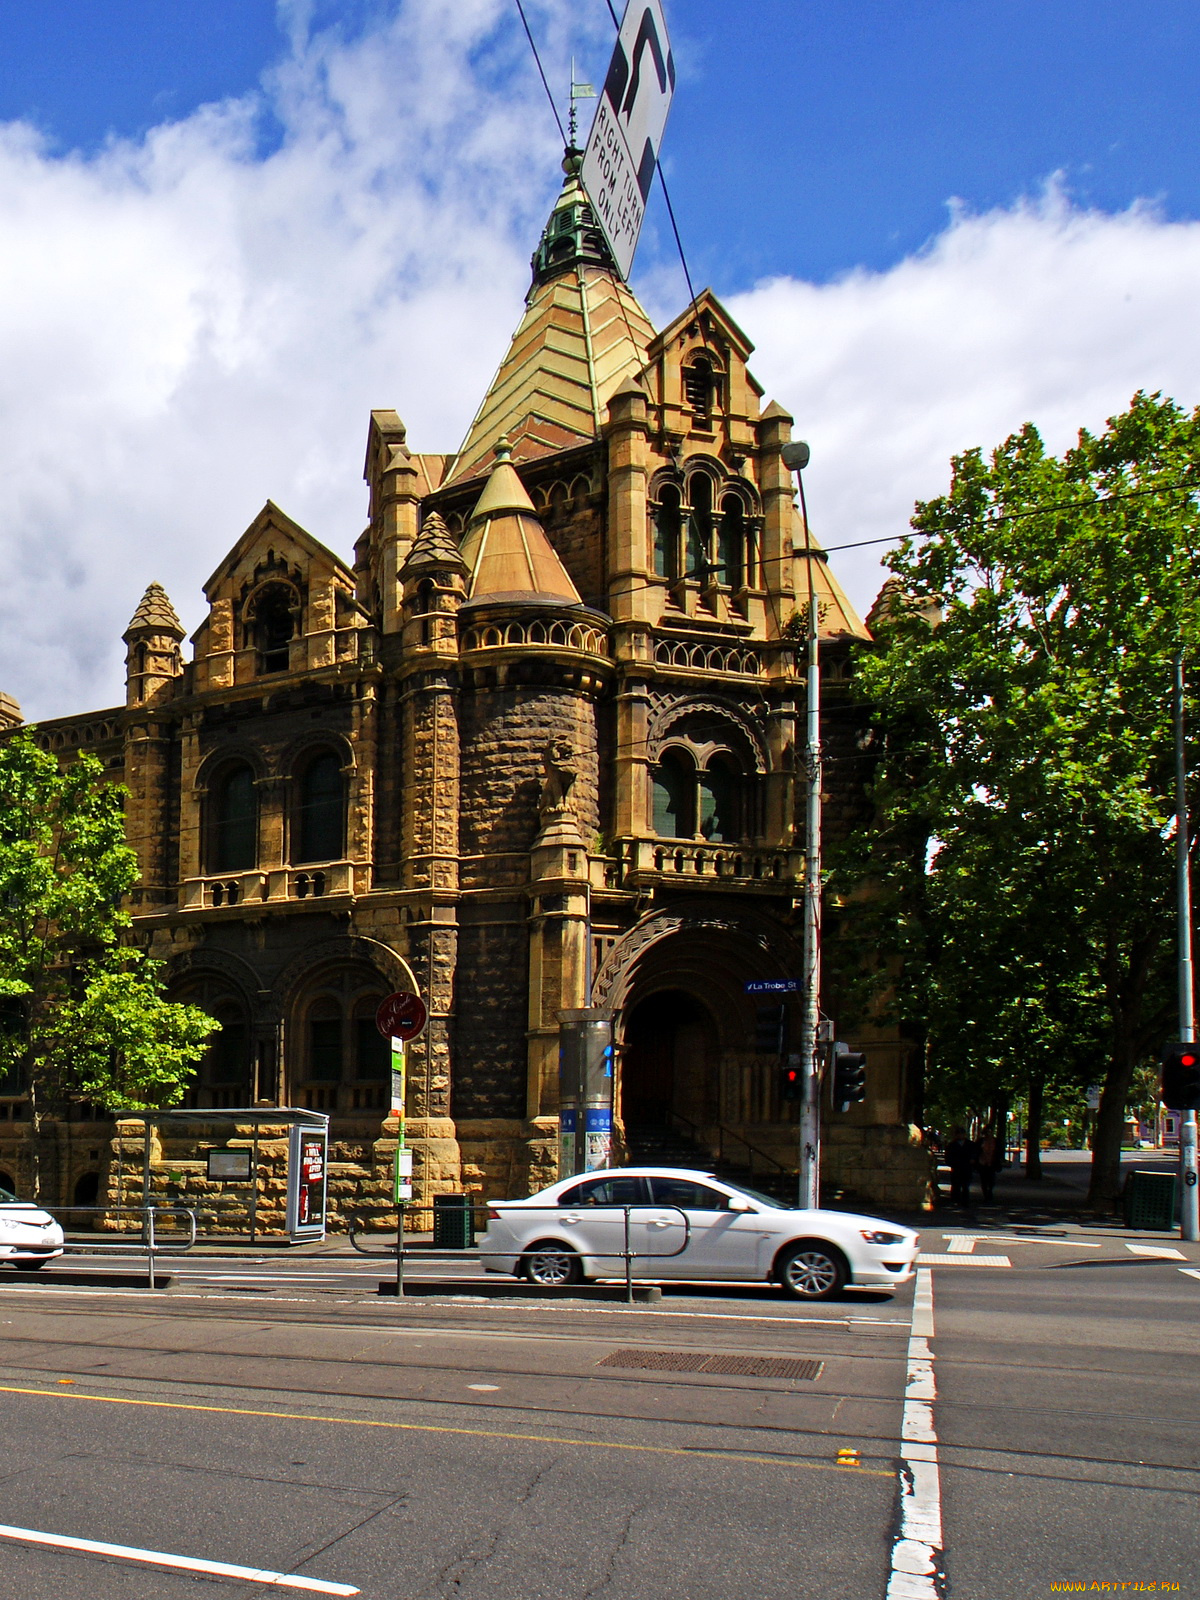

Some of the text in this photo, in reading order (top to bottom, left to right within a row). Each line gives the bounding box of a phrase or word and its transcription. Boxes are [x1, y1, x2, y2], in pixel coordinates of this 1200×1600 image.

[593, 134, 636, 247] FROM LEFT
[598, 105, 642, 229] RIGHT TURN
[598, 189, 620, 243] ONLY
